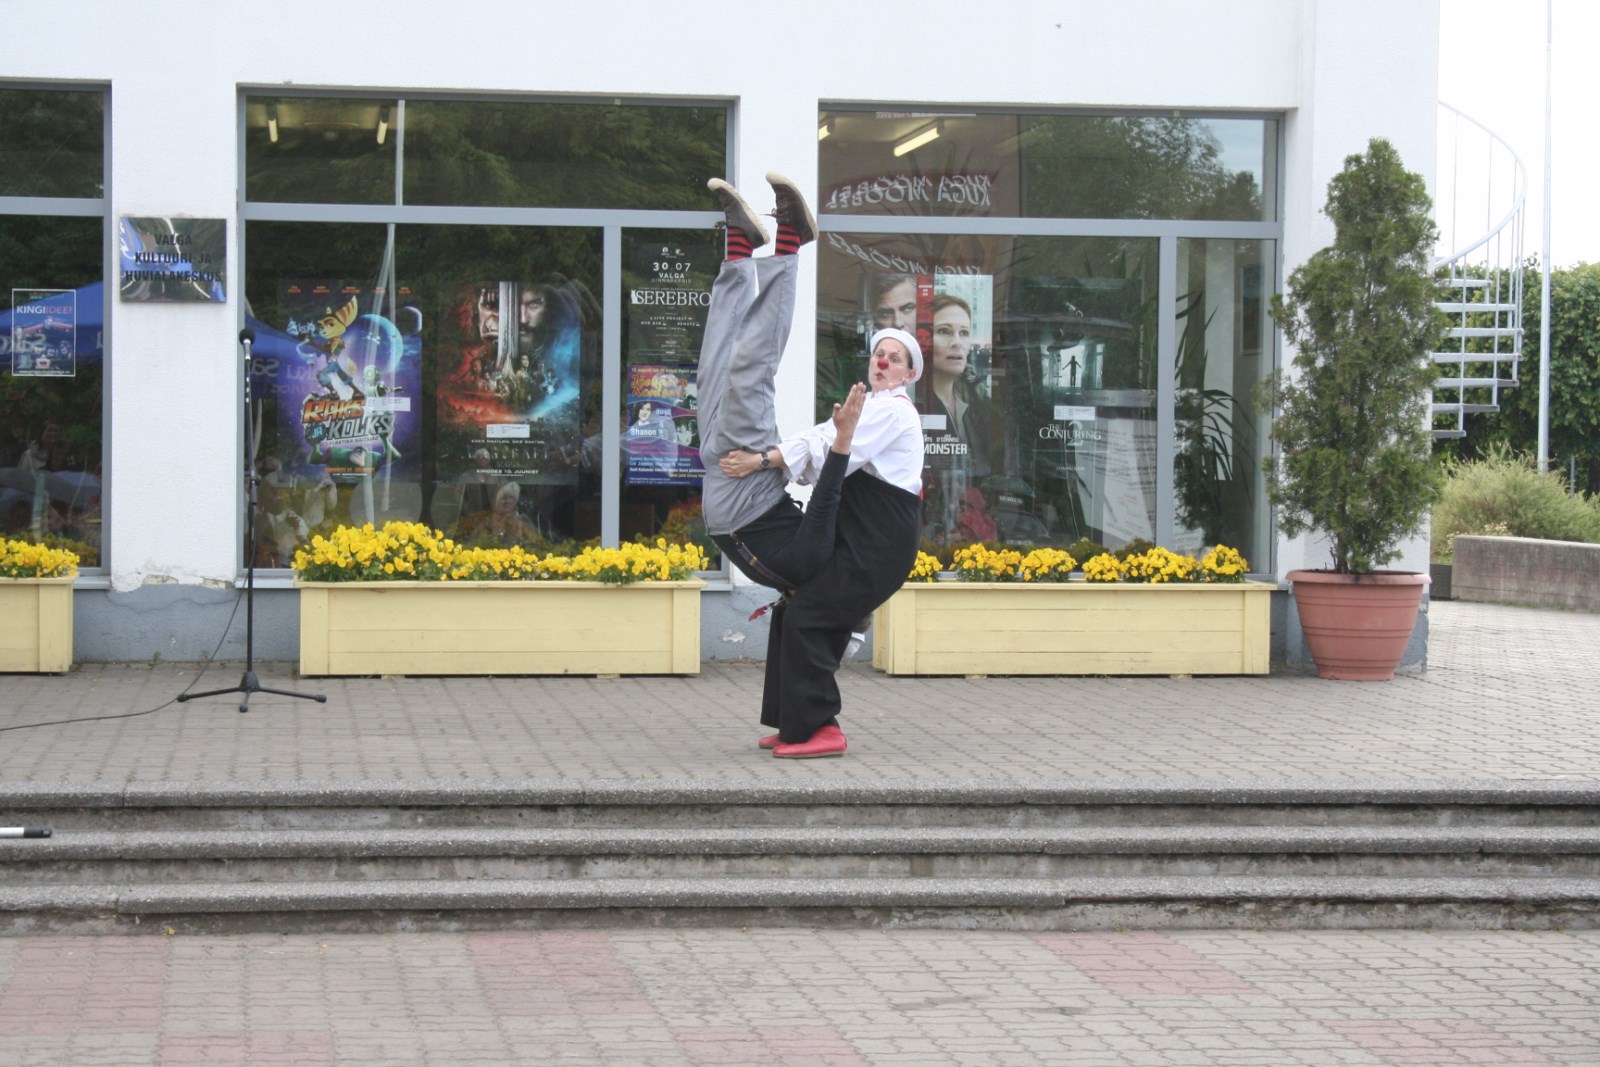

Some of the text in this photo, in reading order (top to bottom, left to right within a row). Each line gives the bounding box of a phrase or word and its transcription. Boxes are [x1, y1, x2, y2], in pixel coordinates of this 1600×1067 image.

[155, 234, 192, 245] VALGA
[125, 270, 222, 281] HUVIALAKESKUS
[636, 291, 712, 306] SEREBRO
[630, 428, 657, 436] Shanon
